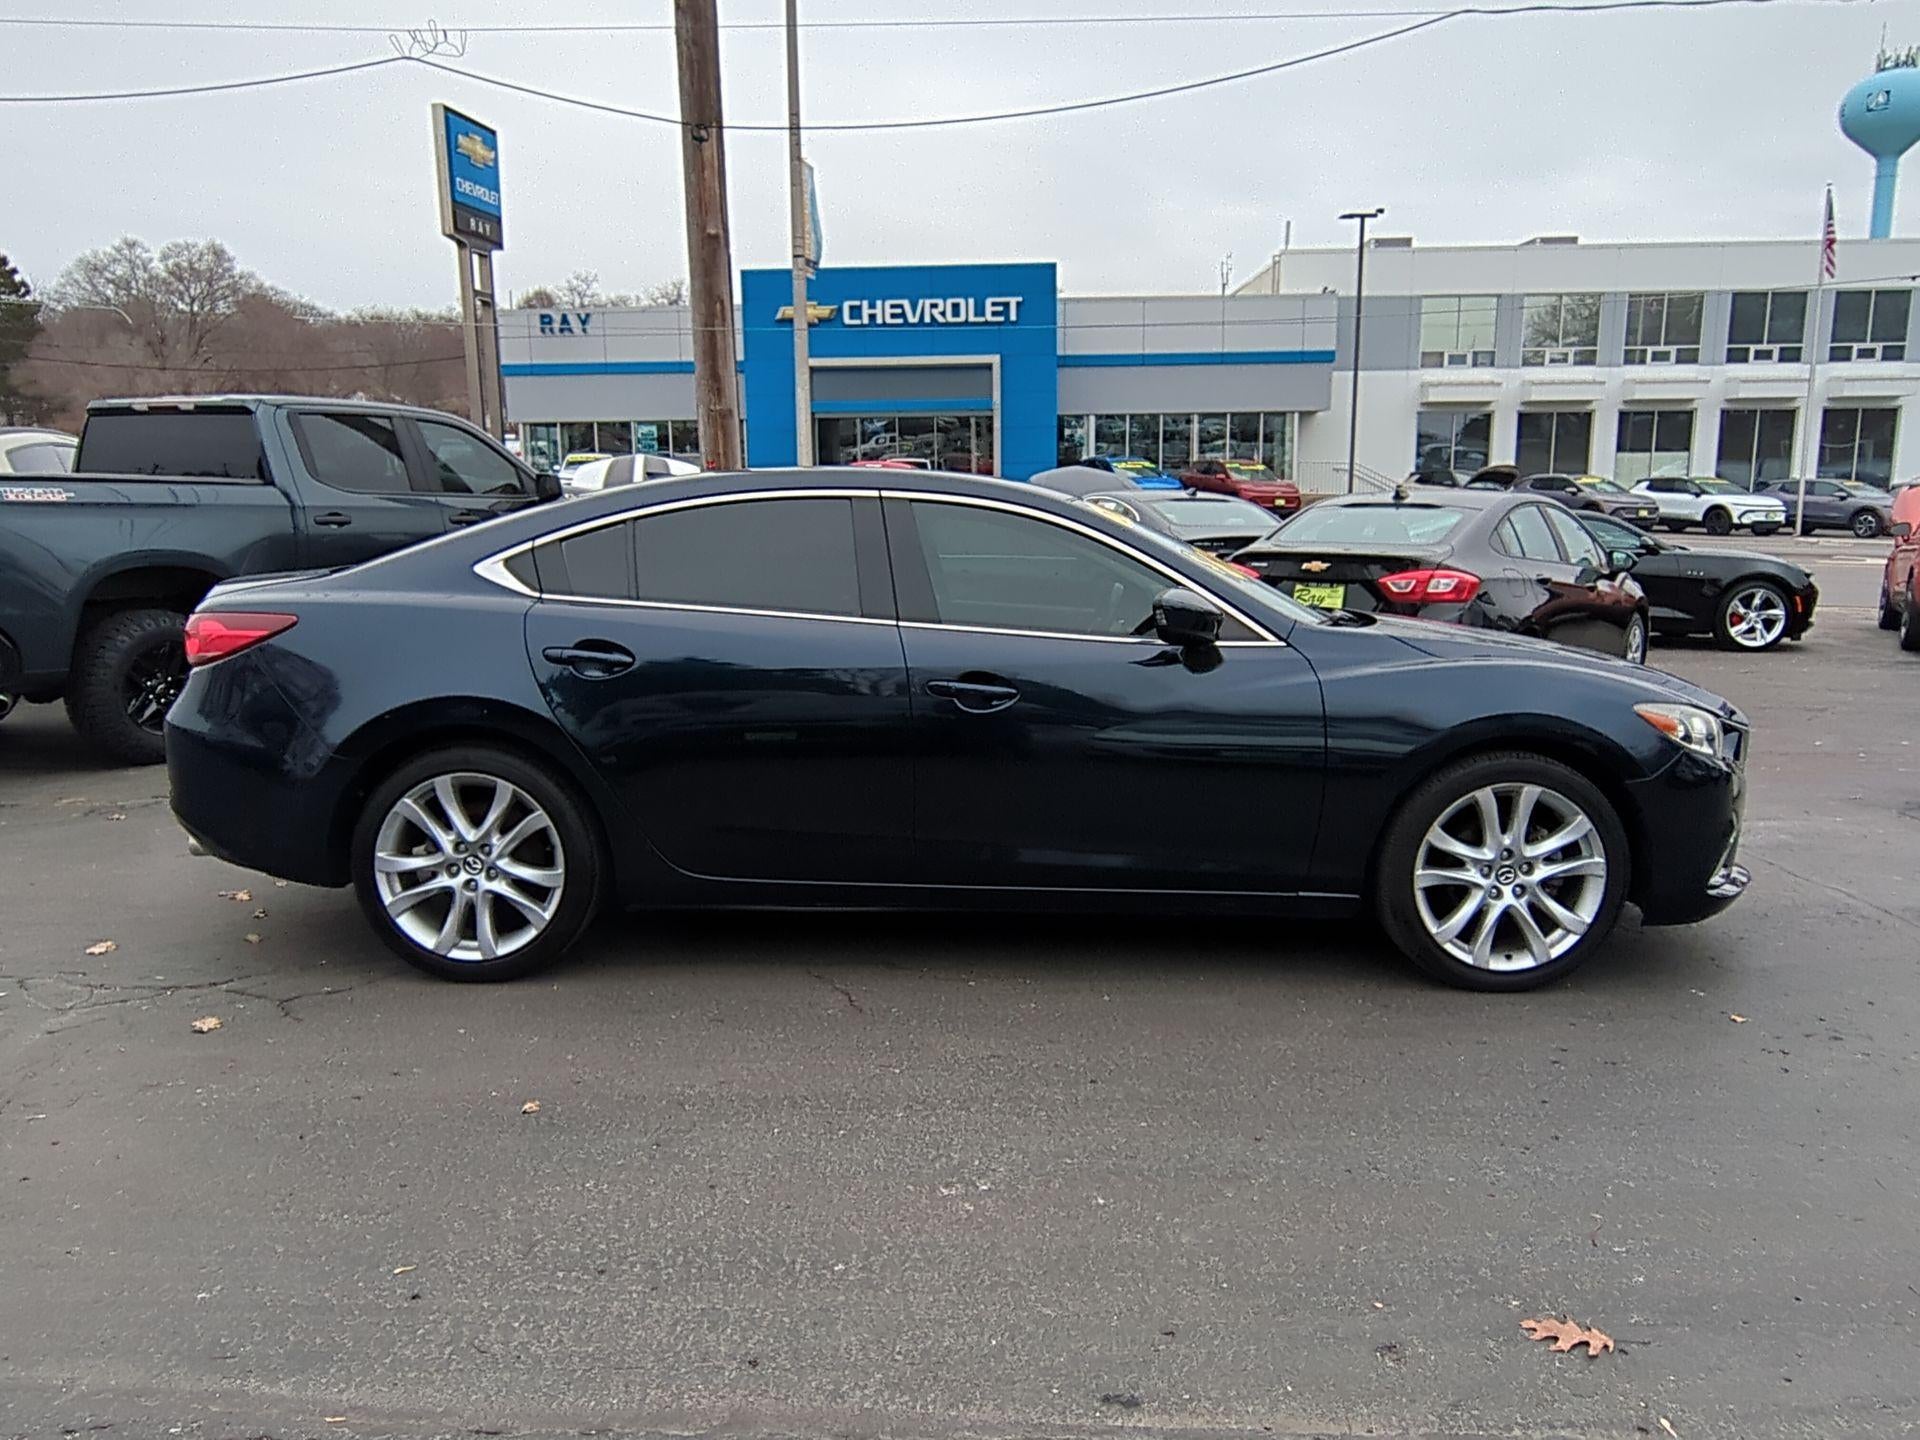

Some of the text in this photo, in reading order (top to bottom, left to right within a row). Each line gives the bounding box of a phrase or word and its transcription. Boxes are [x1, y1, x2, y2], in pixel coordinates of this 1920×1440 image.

[456, 177, 499, 206] CHEVROLET
[470, 217, 490, 236] RAY
[842, 296, 1023, 325] CHEVROLET
[539, 313, 590, 334] RAY
[1295, 588, 1325, 605] Ray
